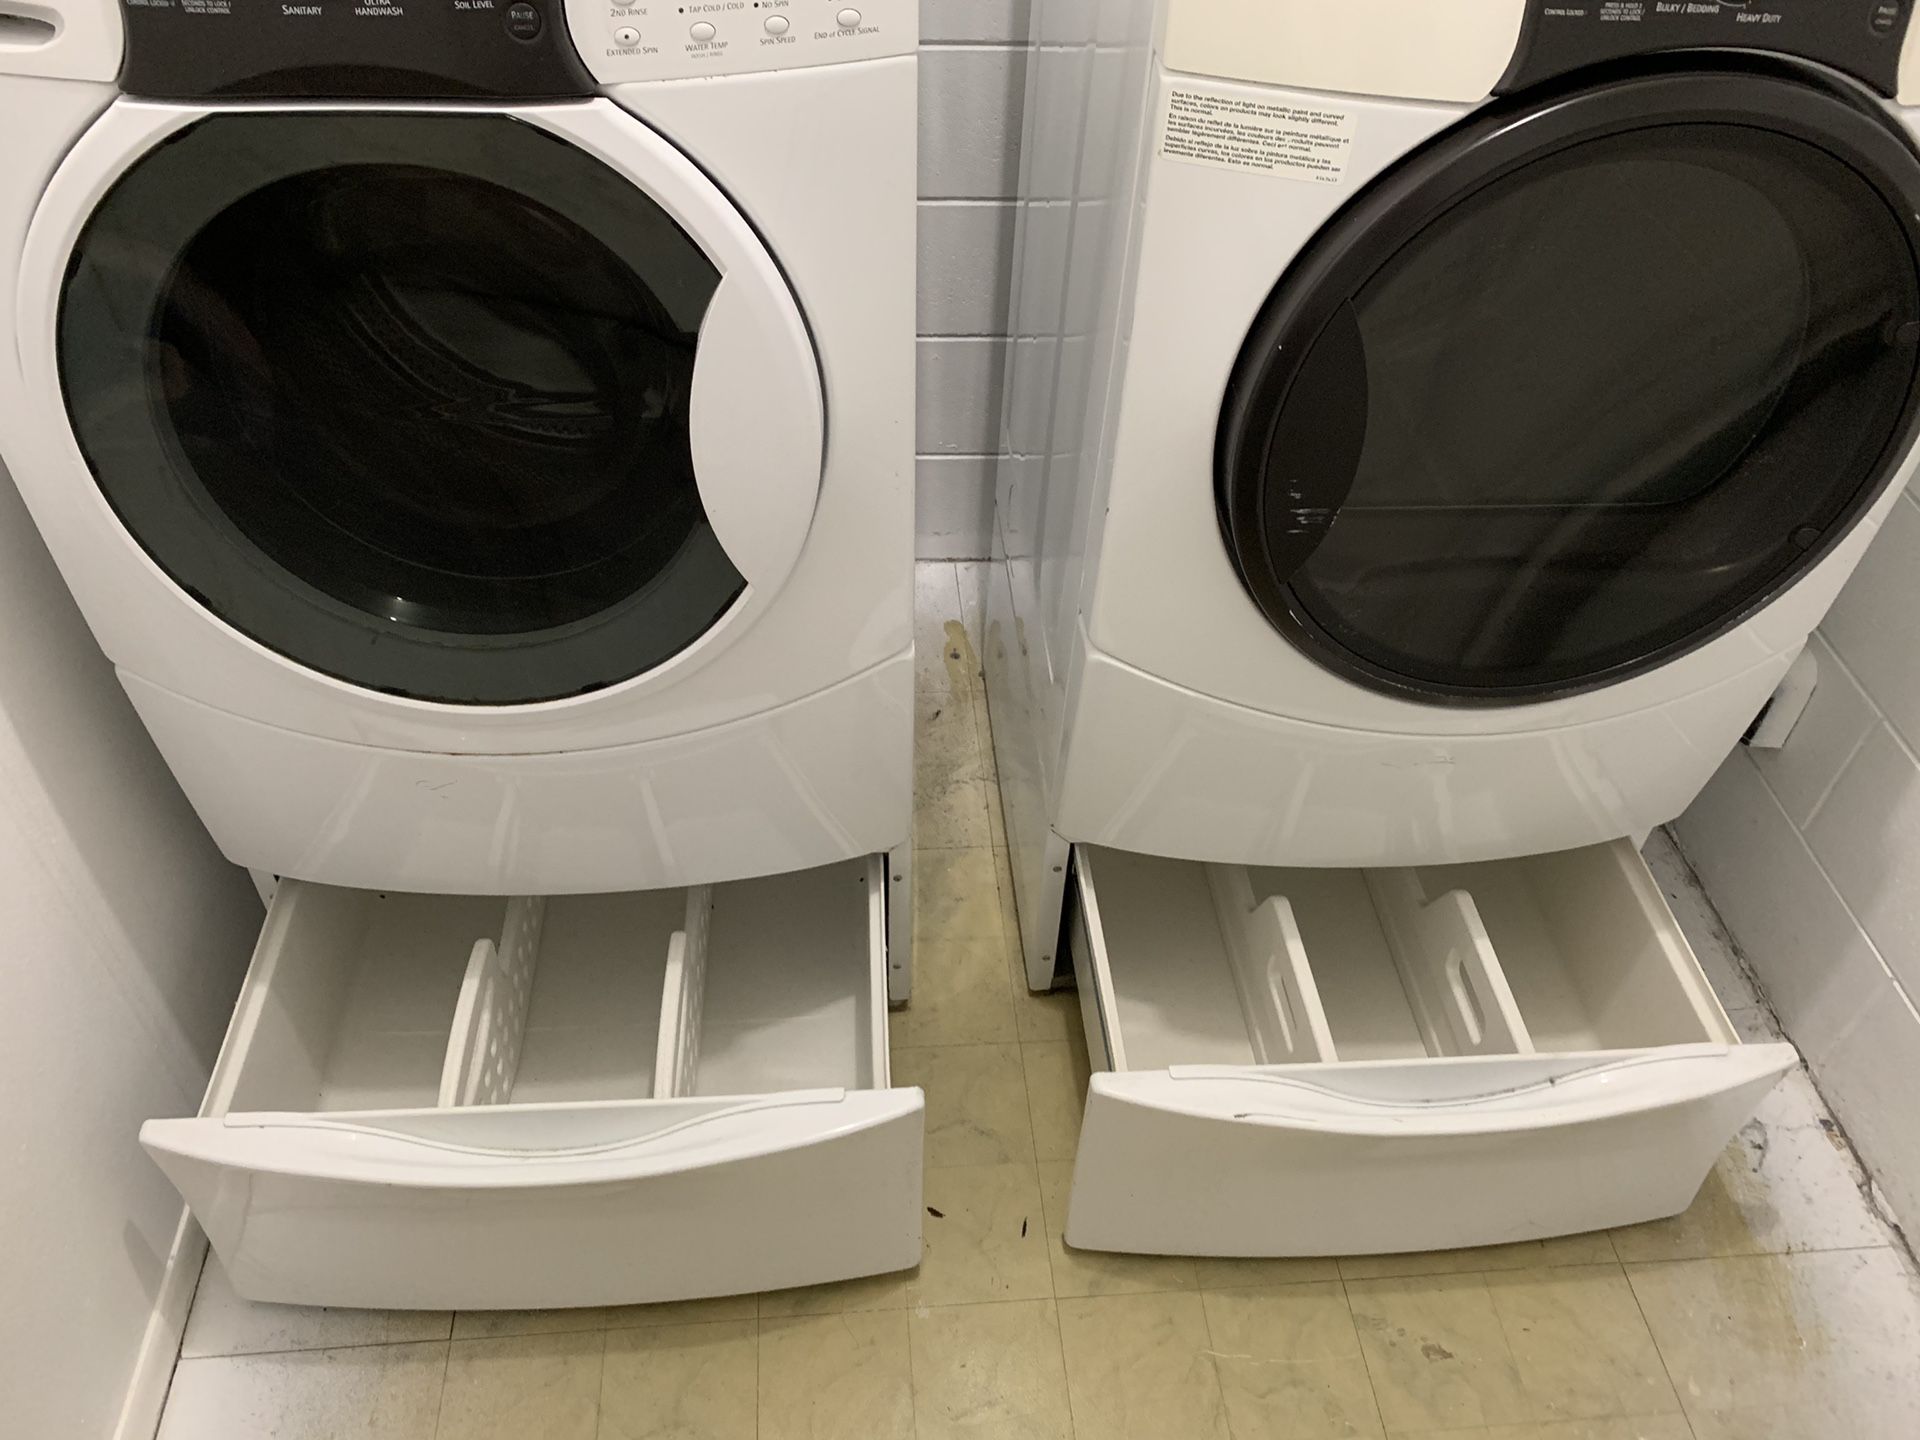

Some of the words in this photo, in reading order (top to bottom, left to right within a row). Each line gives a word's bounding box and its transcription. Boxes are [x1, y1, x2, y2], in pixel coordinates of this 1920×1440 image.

[455, 0, 471, 9] SOIL
[472, 0, 494, 8] LEVEL
[689, 6, 701, 14] TAP
[703, 4, 721, 12] COLD
[727, 2, 745, 10] COLD
[1656, 2, 1680, 12] BULKY
[1687, 3, 1720, 13] BEDDING
[282, 4, 322, 15] SANITARY
[355, 7, 403, 16] HANDWASH
[628, 8, 648, 16] RINSE
[1736, 12, 1761, 23] HEAVY
[1762, 13, 1782, 23] DUTY
[858, 26, 880, 35] SIGNAL
[606, 48, 641, 57] EXTENDED
[685, 44, 709, 52] WATER
